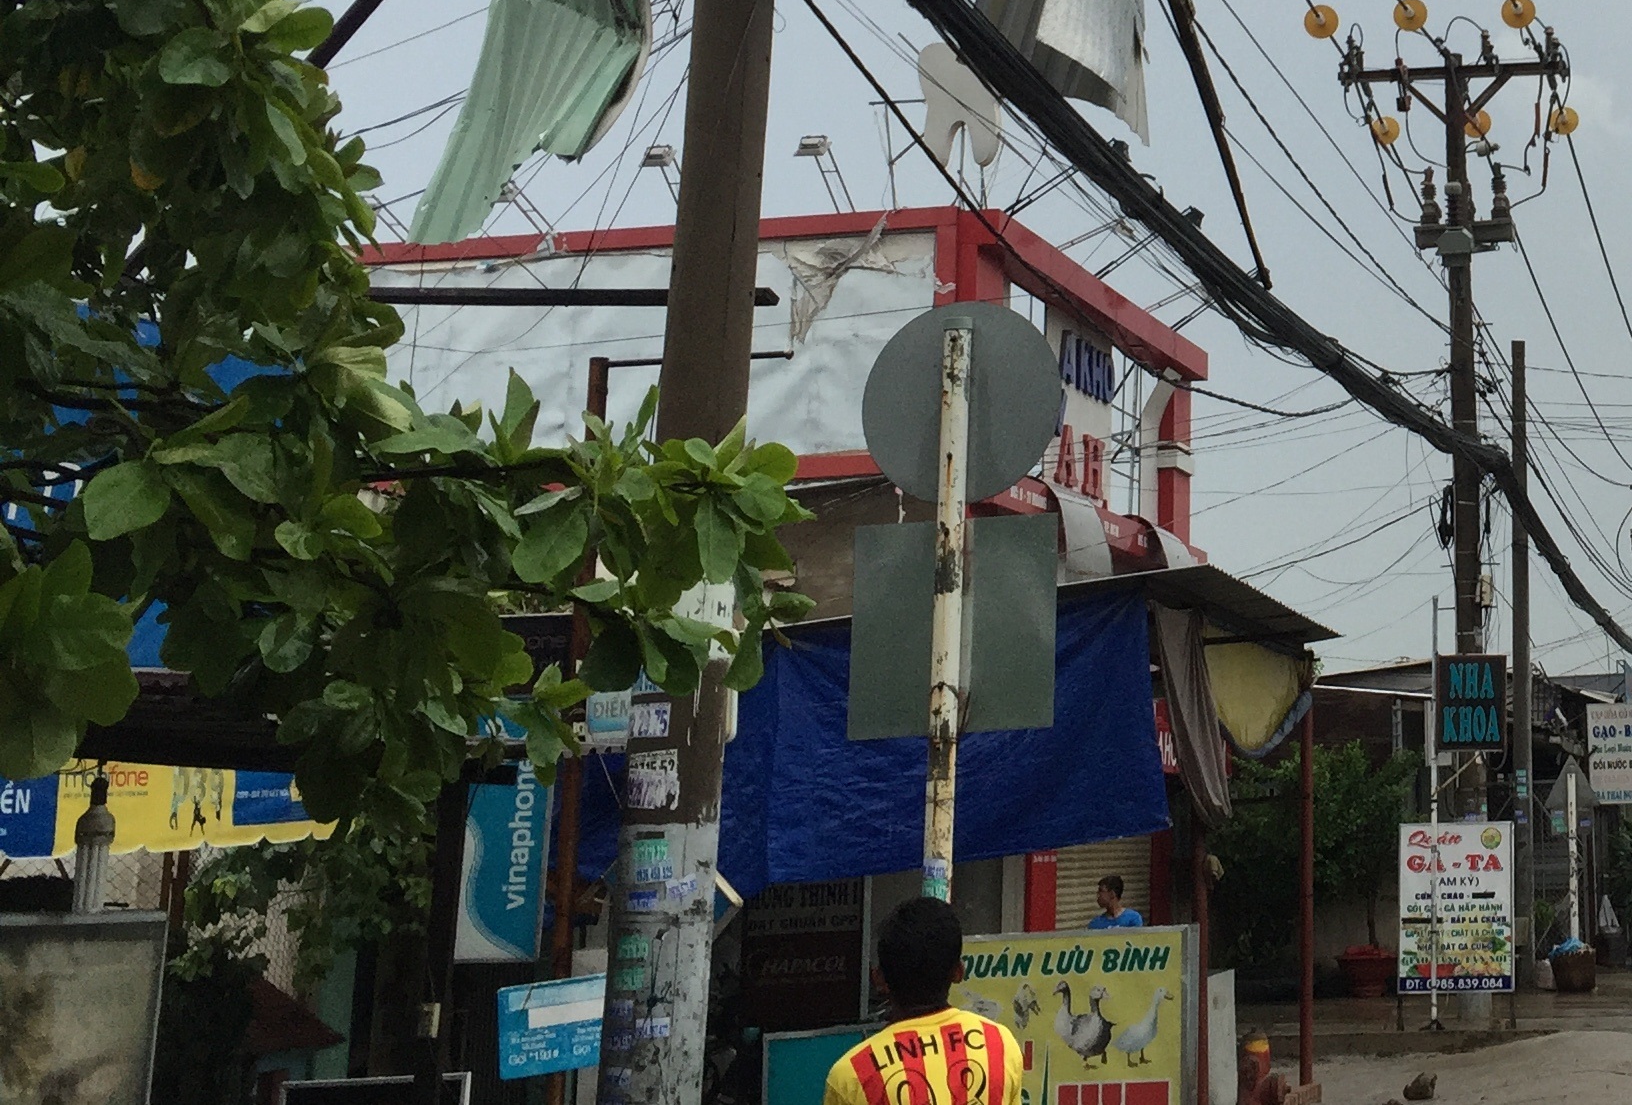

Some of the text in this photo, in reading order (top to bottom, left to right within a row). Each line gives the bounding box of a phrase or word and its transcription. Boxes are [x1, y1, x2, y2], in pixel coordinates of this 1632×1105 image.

[1449, 662, 1495, 700] NHA
[1442, 705, 1501, 743] KHOA
[1592, 724, 1616, 741] GẠO
[62, 764, 149, 788] mofone
[502, 758, 535, 910] vinaphone
[1465, 853, 1504, 873] TA
[1101, 940, 1171, 974] BÌNH
[1406, 978, 1424, 990] ĐT:
[868, 1028, 986, 1073] LINH FC
